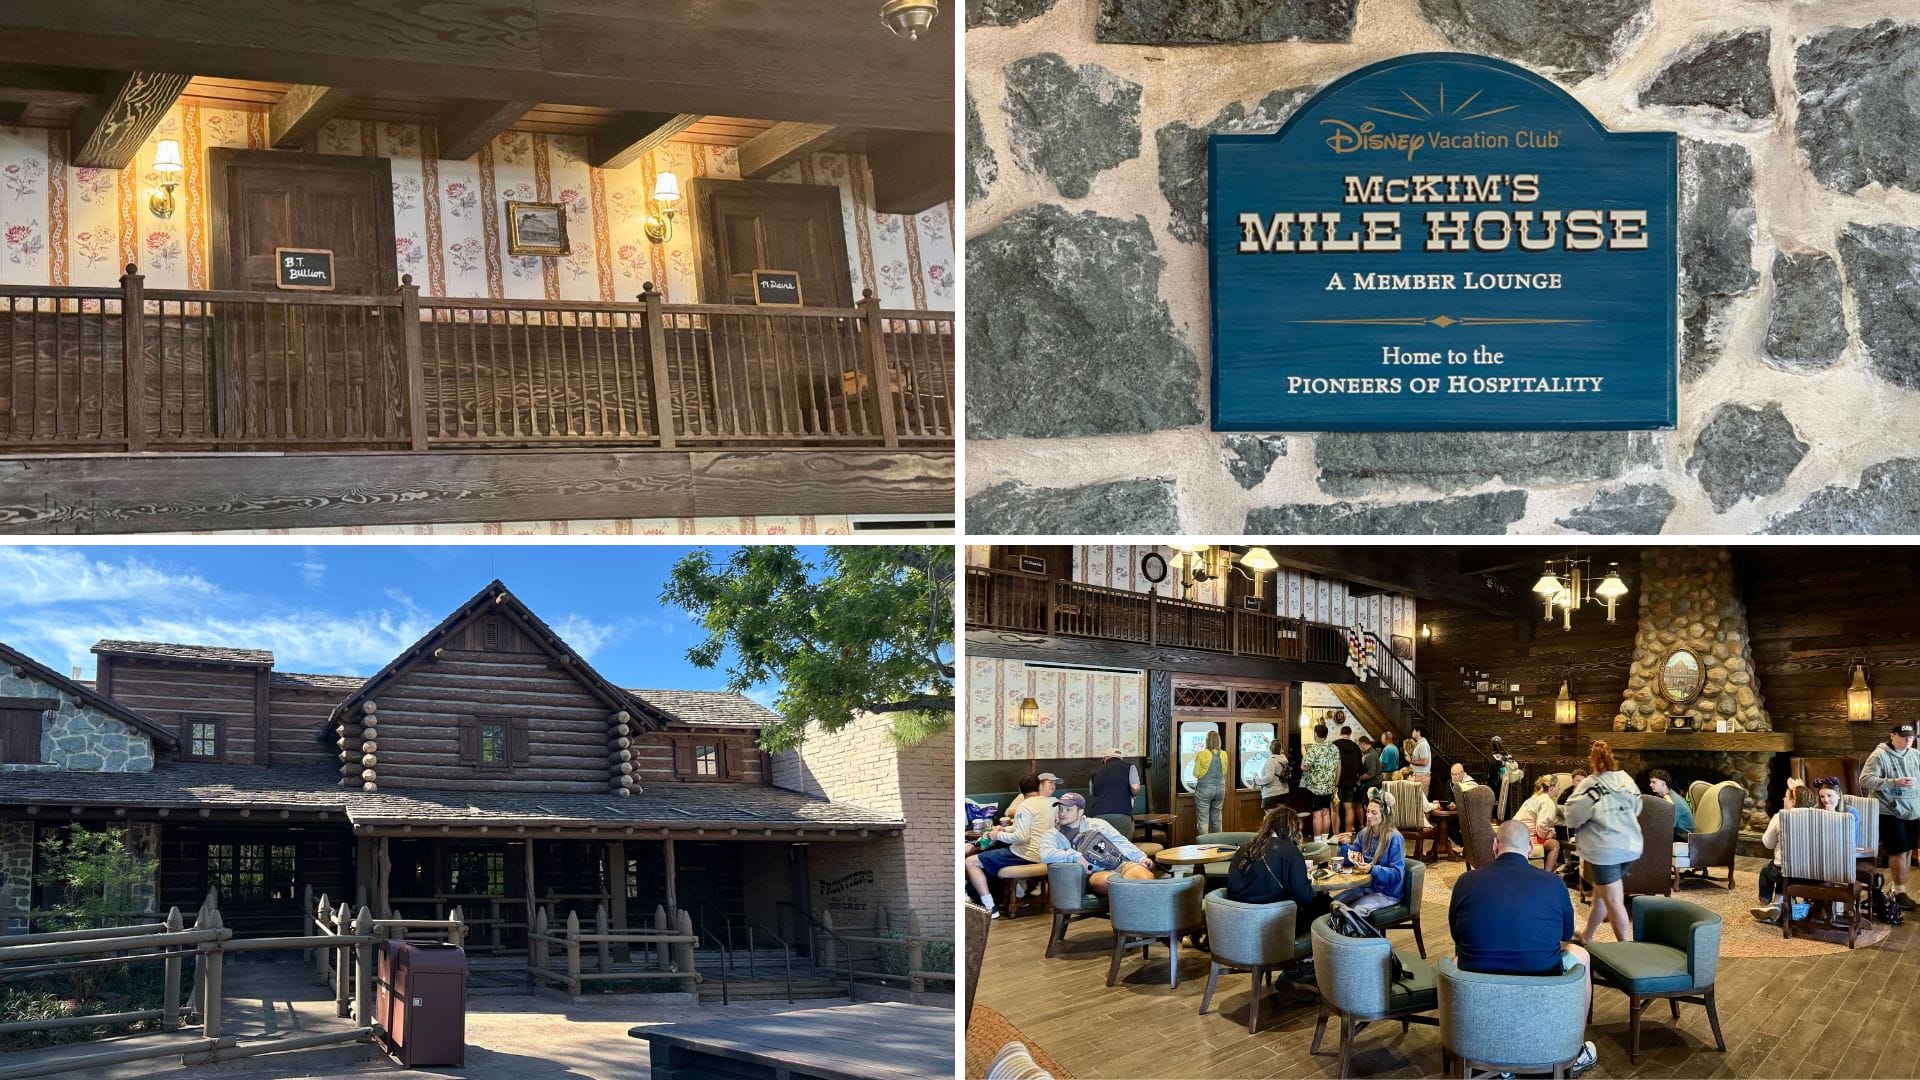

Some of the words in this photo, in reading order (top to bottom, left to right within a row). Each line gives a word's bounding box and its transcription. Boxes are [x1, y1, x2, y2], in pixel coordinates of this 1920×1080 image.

[1320, 119, 1425, 162] Disney
[1427, 131, 1509, 149] Vacation
[1515, 130, 1560, 149] Club
[1343, 174, 1541, 204] McKIM'S
[1237, 211, 1402, 253] MILE
[1423, 210, 1649, 252] HOUSE
[284, 257, 304, 268] B.T.
[289, 269, 326, 280] Bullion
[1325, 273, 1346, 291] A
[1353, 272, 1456, 291] MEMBER
[1464, 271, 1563, 290] LOUNGE
[770, 280, 796, 290] Davis
[1382, 346, 1442, 365] Home
[1448, 349, 1468, 365] to
[1473, 345, 1504, 364] the
[1287, 376, 1402, 394] PIONEERS
[1410, 377, 1440, 394] OF
[1447, 375, 1604, 393] HOSPITALITY
